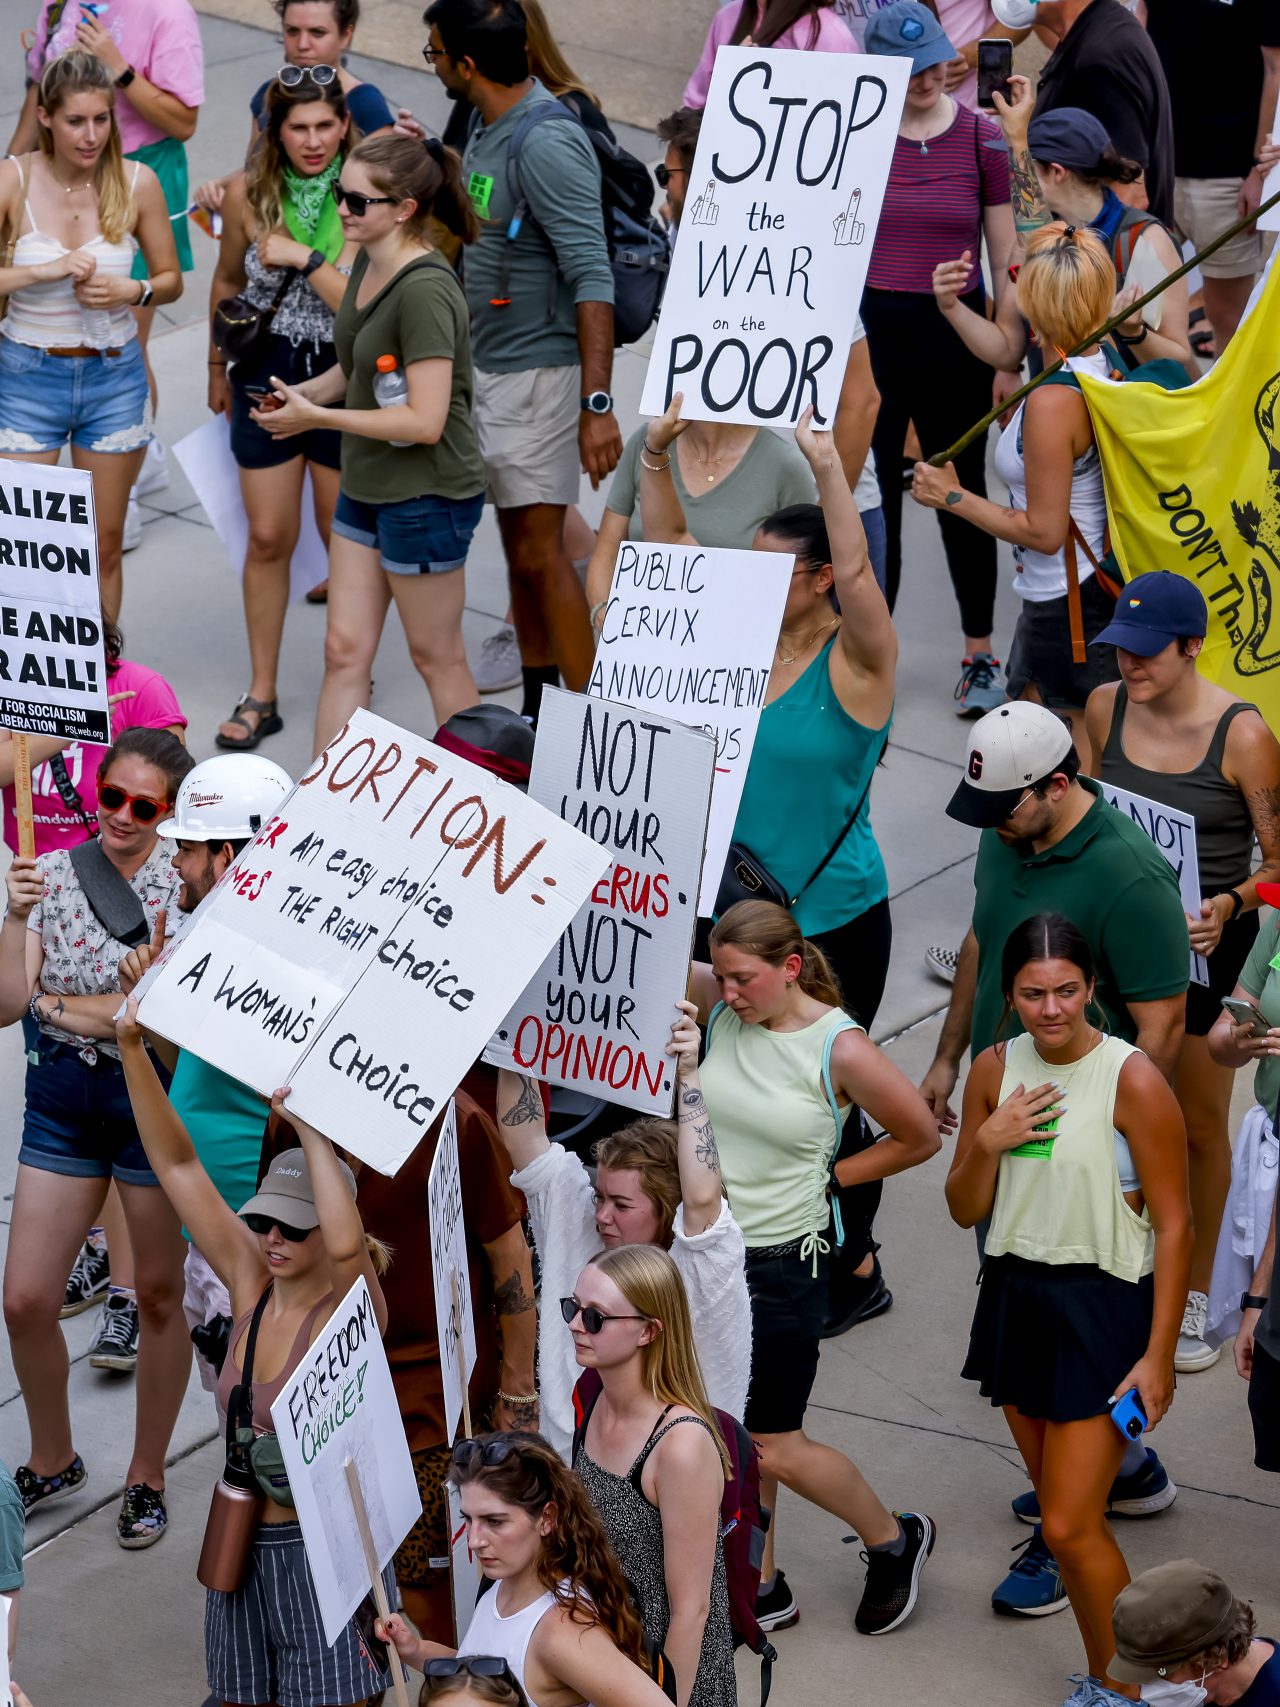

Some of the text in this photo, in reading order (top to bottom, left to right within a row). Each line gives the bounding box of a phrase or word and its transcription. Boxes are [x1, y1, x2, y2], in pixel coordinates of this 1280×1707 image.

[712, 61, 888, 190] STOP
[746, 202, 785, 231] the
[698, 241, 815, 309] WAR
[712, 314, 766, 331] on the
[664, 333, 833, 426] POOR
[1157, 483, 1228, 579] DON'T
[615, 545, 706, 593] PUBLIC
[25, 611, 99, 647] AND
[601, 597, 699, 647] CERVIX
[19, 653, 98, 693] ALL!
[587, 660, 769, 709] ANNOUNCEMENT
[6, 699, 26, 714] FOR
[27, 703, 87, 724] SOCIALISM
[576, 703, 671, 803] NOT
[968, 749, 984, 781] G
[189, 793, 224, 804] Milwaukee
[325, 846, 375, 899] easy
[379, 867, 455, 930] choice
[279, 884, 315, 925] THE
[320, 905, 380, 952] RIGHT
[376, 938, 476, 1013] choice
[557, 909, 652, 990] NOT
[177, 952, 212, 995] A
[213, 964, 316, 1045] WOMAN'S
[275, 1167, 302, 1178] Daddy
[288, 1289, 375, 1440] FREEDOM
[301, 1360, 369, 1465] CHOICE!
